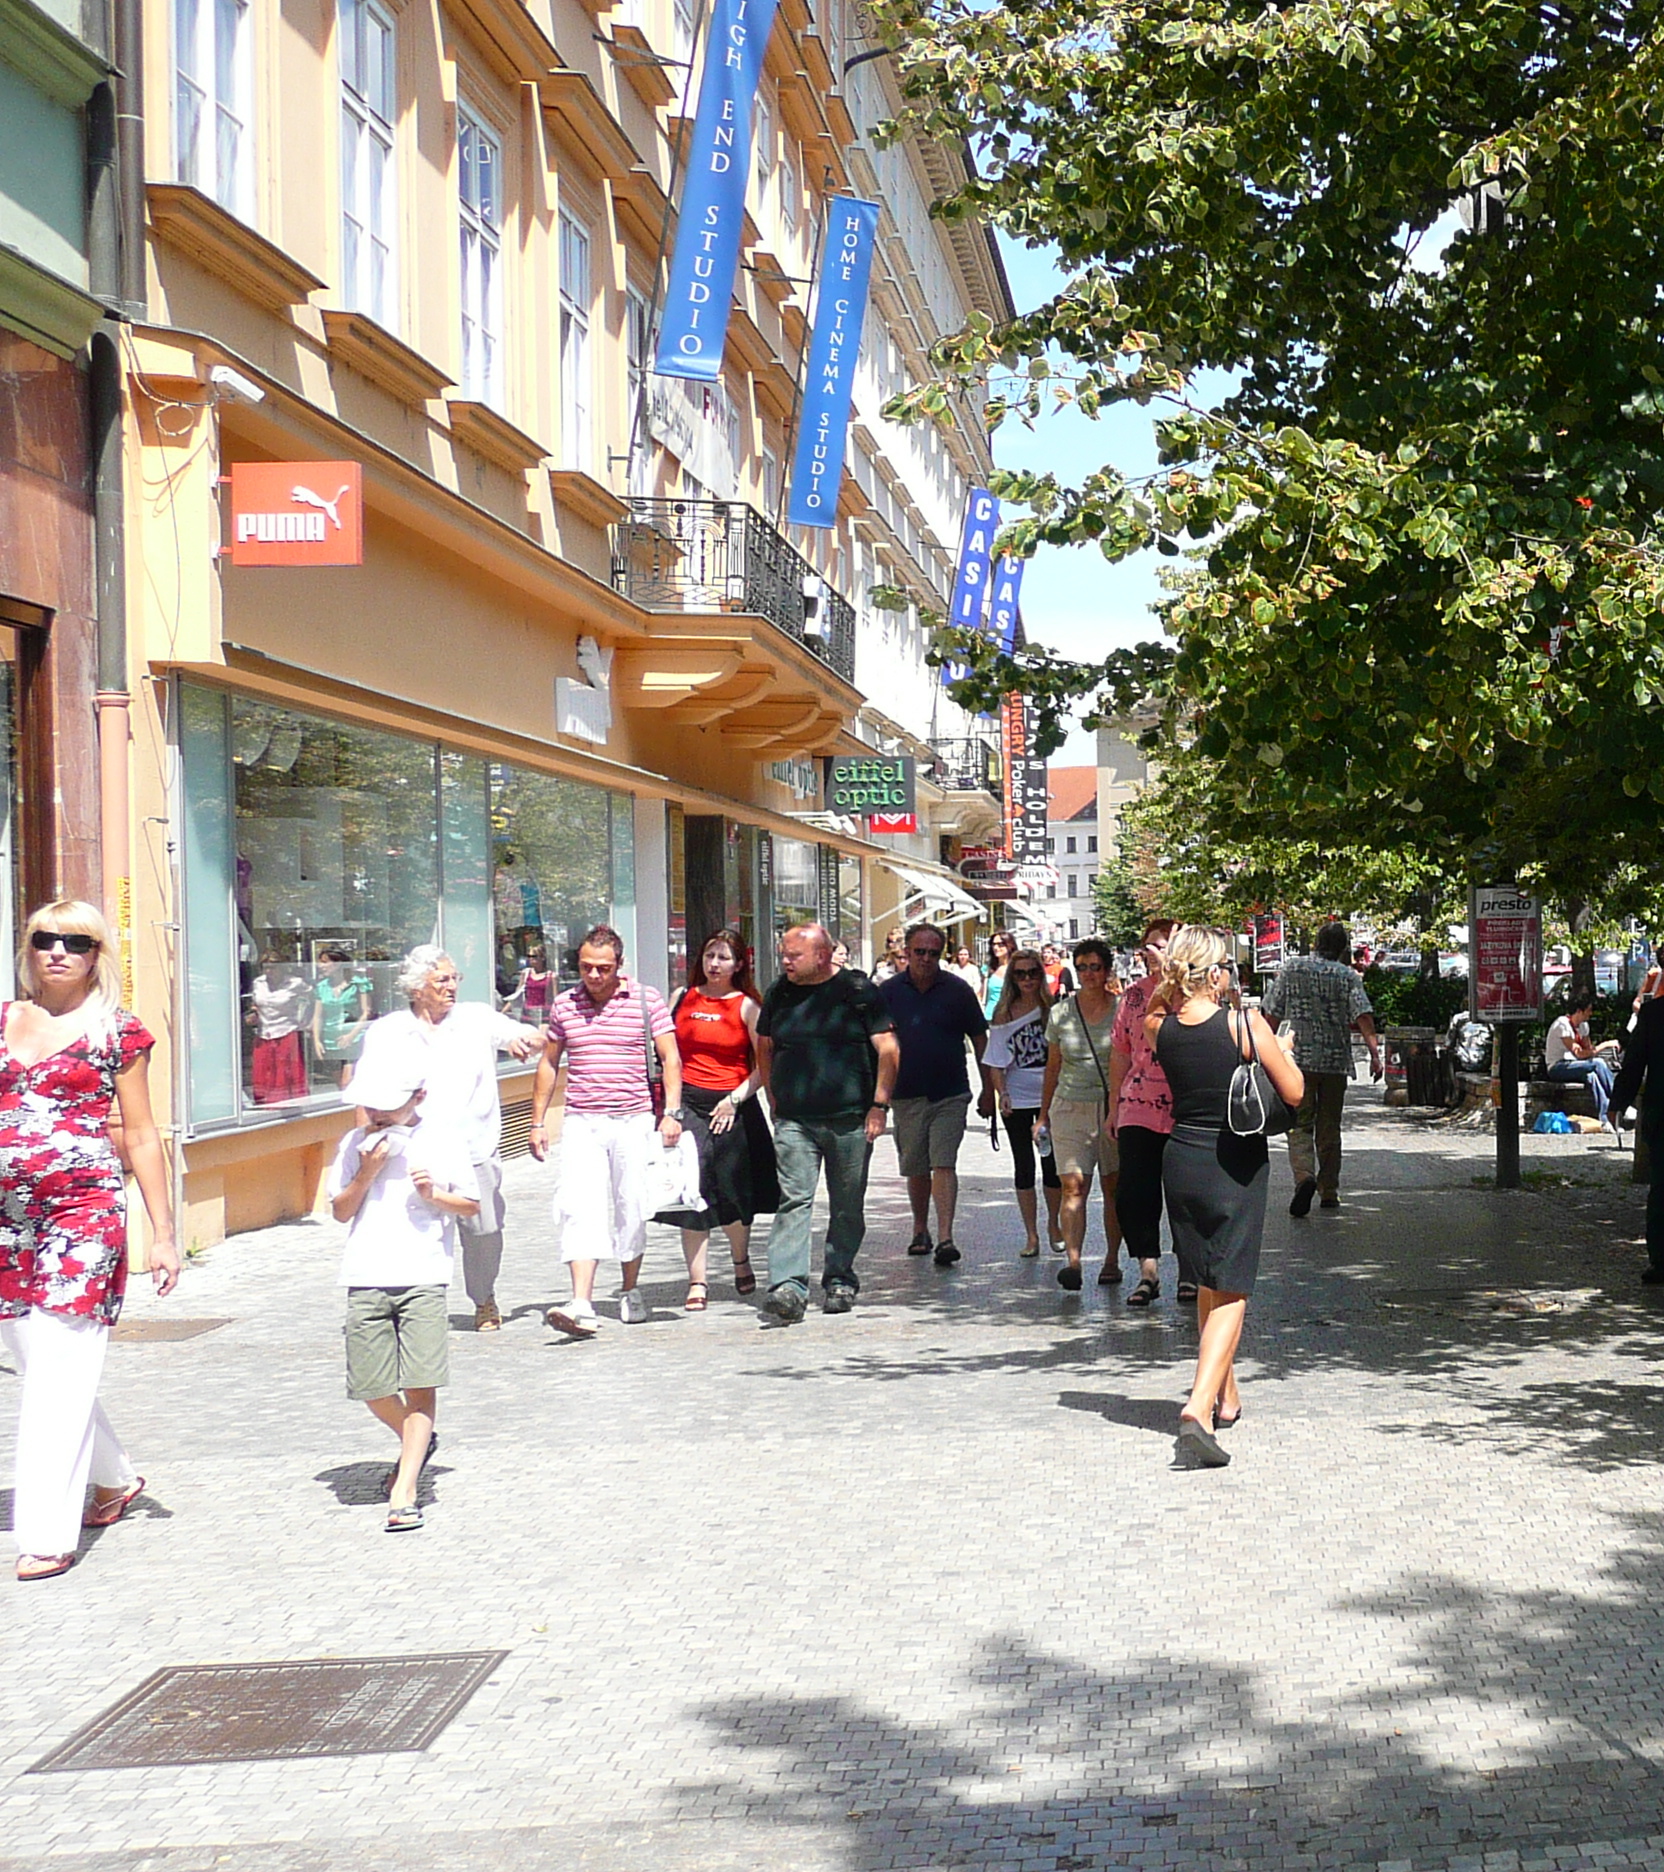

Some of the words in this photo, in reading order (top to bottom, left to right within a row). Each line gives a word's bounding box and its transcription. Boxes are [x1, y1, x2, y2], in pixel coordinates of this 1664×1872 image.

[725, 0, 747, 70] IGH
[710, 100, 734, 173] END
[840, 217, 859, 281] HOME
[680, 205, 720, 355] STUDIO
[821, 299, 849, 395] CINEMA
[806, 413, 829, 508] STUDIO
[238, 513, 325, 542] PUMA
[834, 759, 905, 782] eiffel
[834, 783, 906, 811] optic
[1012, 761, 1025, 804] Poker
[1012, 818, 1025, 852] club
[1481, 900, 1532, 913] presto
